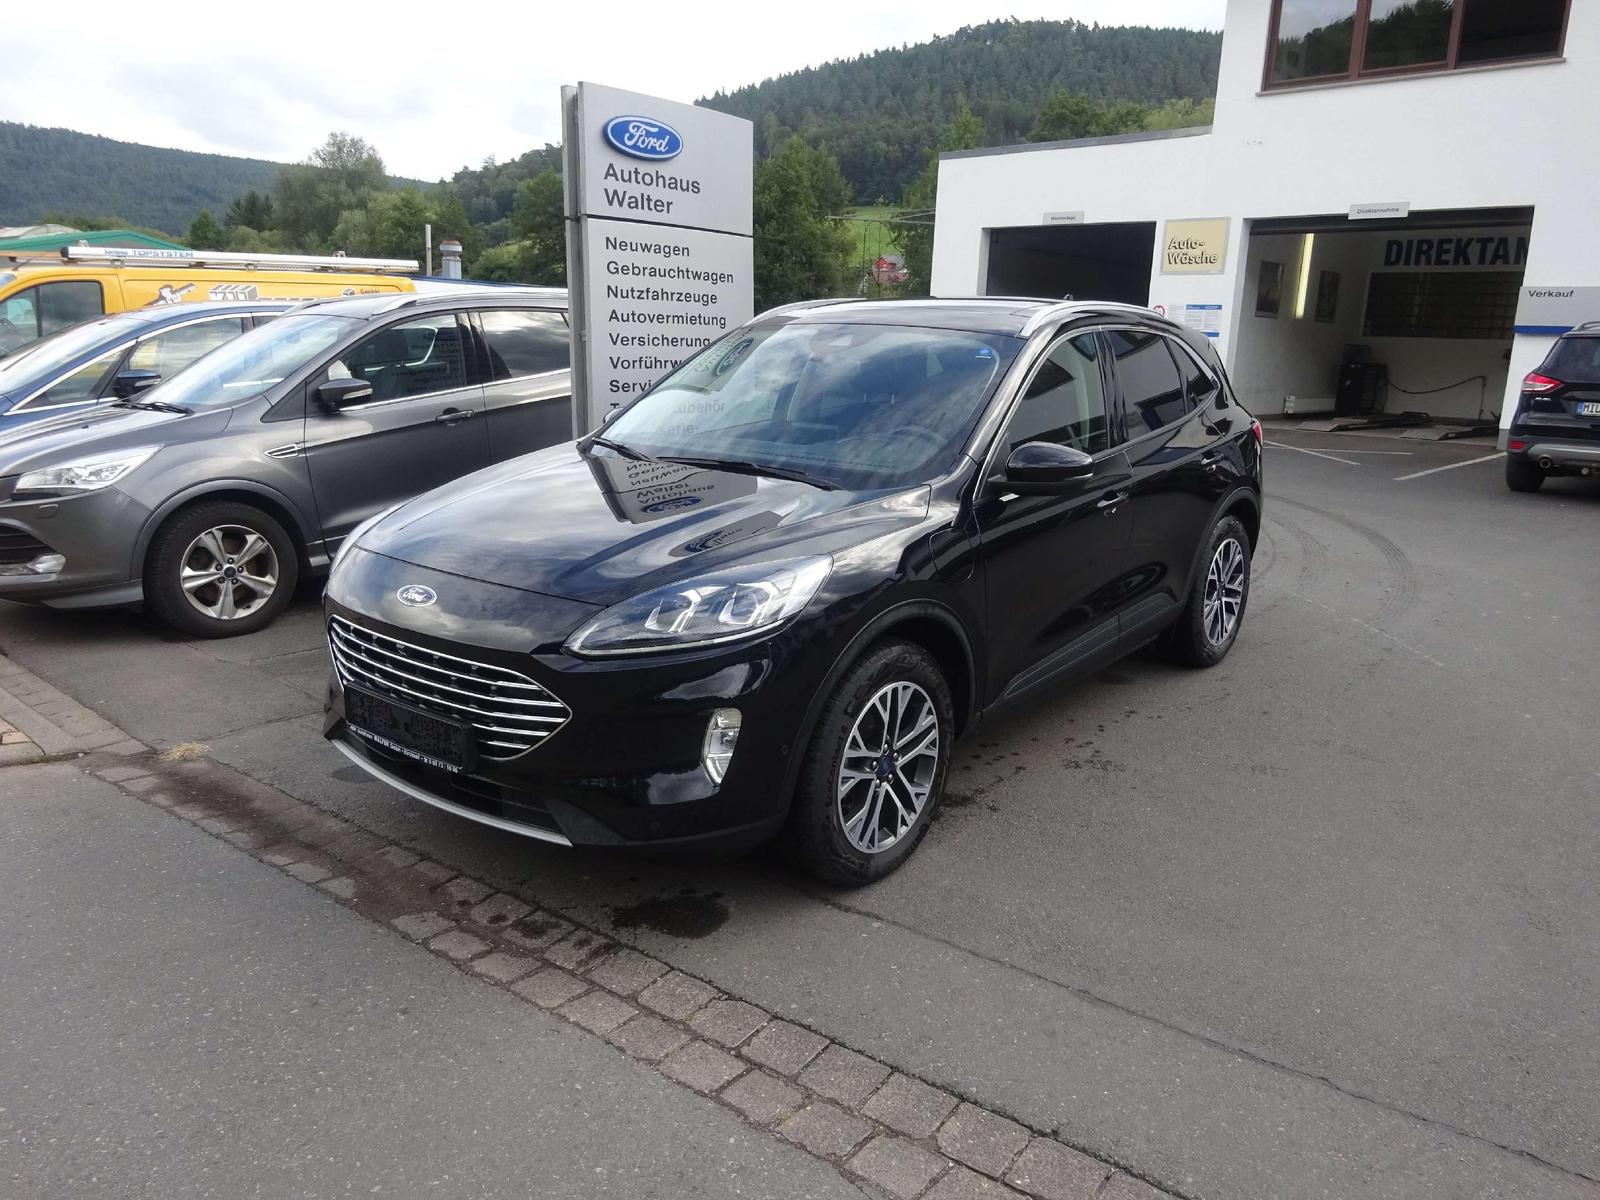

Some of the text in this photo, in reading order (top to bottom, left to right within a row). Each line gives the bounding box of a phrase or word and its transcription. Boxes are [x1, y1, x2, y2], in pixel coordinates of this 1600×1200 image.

[624, 121, 669, 153] Ford
[603, 162, 701, 195] Autohaus
[603, 187, 674, 214] Walter
[132, 250, 194, 258] TOPSYSTEM
[605, 236, 690, 258] Neuwagen
[1167, 237, 1205, 250] Auto-
[1167, 251, 1218, 265] Wäsche
[606, 261, 734, 284] Gebrauchtwagen
[606, 285, 718, 307] Nutzfahrzeuge
[1528, 290, 1575, 298] Verkauf
[608, 309, 727, 329] Autovermietung
[402, 587, 428, 602] Ford
